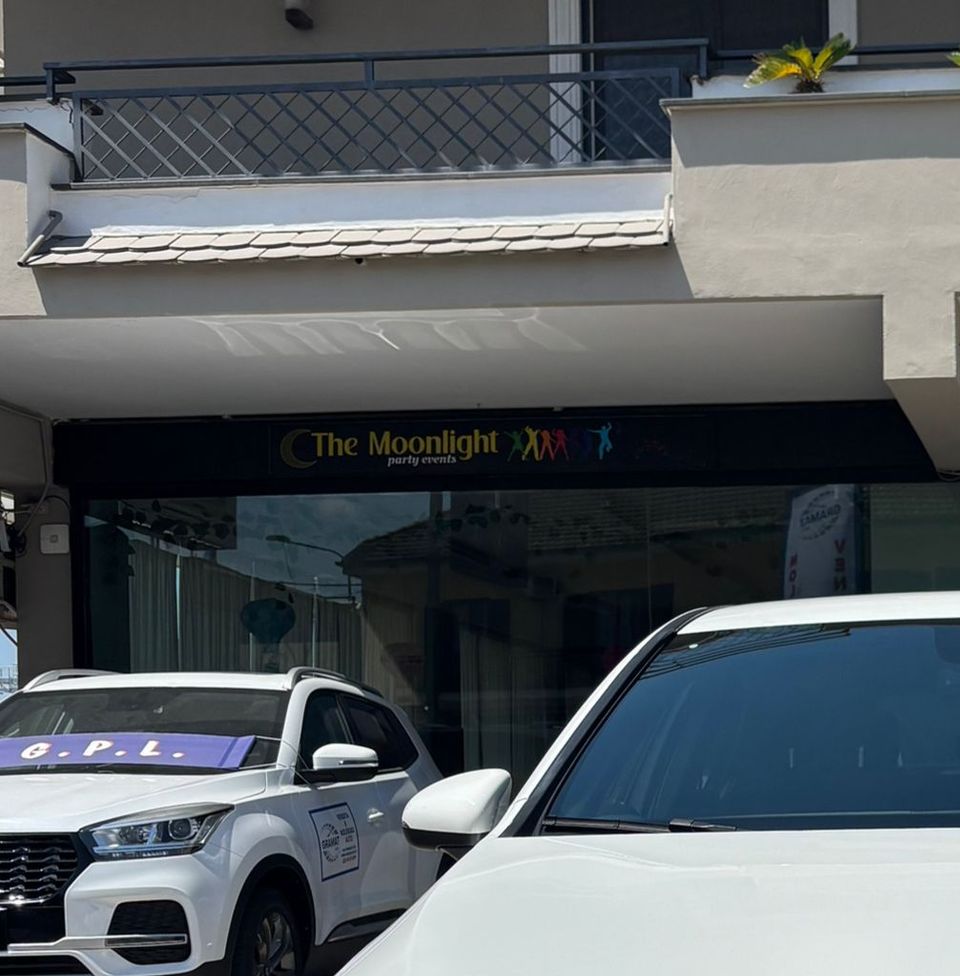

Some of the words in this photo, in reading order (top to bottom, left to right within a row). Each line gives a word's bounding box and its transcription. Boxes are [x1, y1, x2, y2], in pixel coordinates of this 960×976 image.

[310, 431, 359, 458] The
[367, 428, 500, 461] Moonlight
[386, 455, 419, 468] party
[420, 453, 458, 465] events
